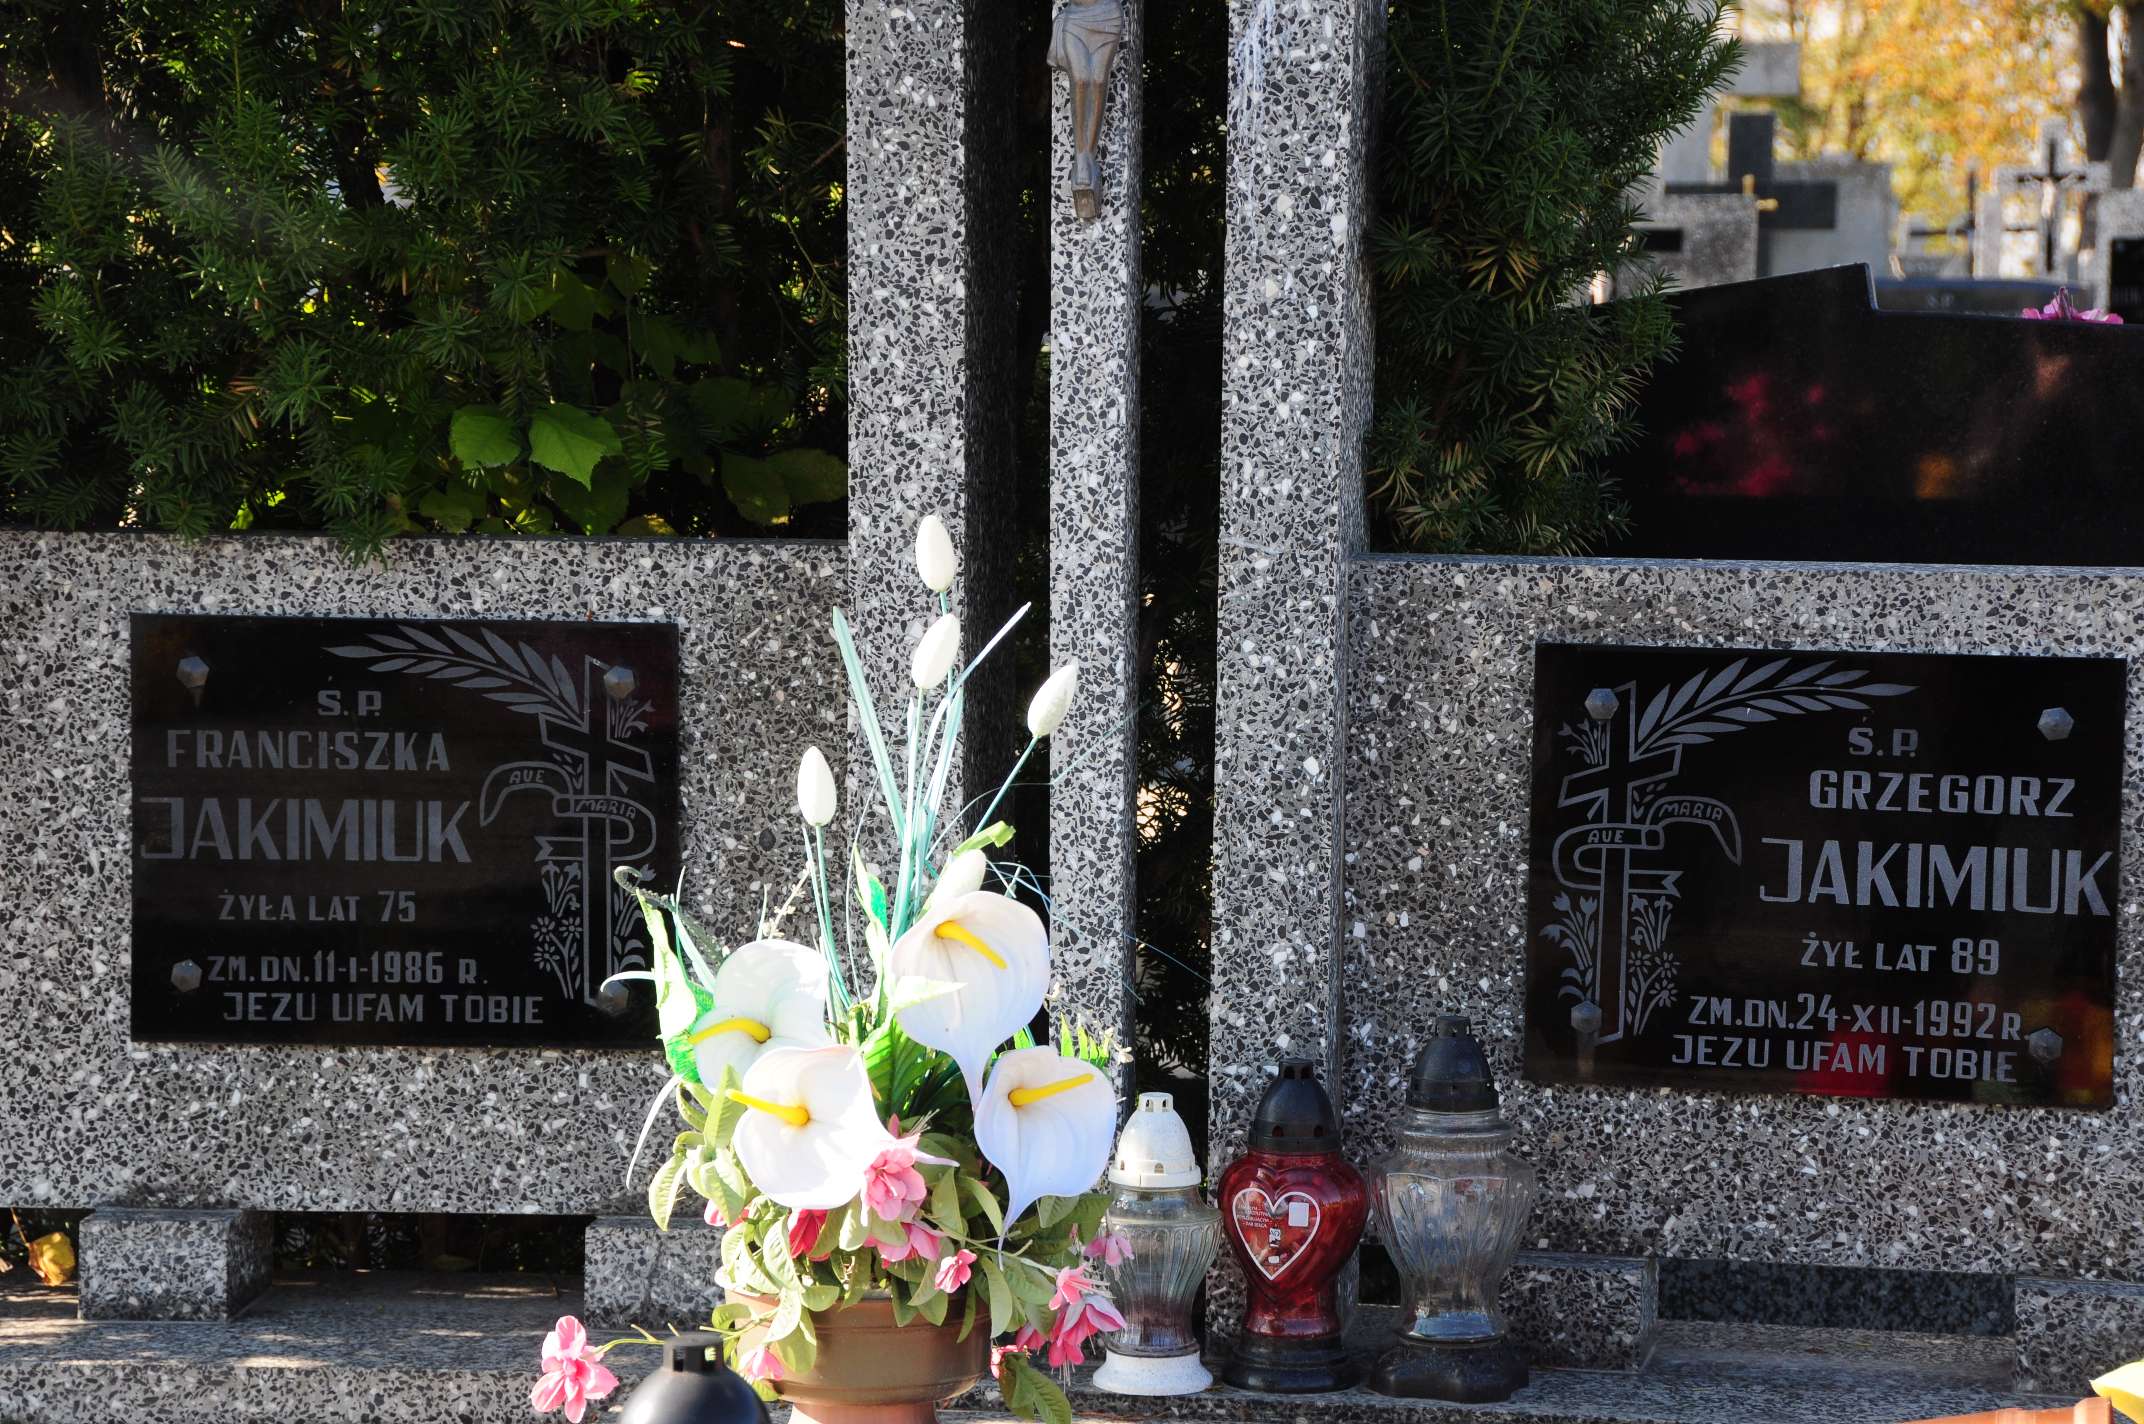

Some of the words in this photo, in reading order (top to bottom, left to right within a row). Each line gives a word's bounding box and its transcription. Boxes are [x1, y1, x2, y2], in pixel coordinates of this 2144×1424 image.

[166, 728, 450, 772] FRANCISZKA
[575, 799, 638, 820] MARIA
[1658, 801, 1724, 822] MARIA
[1808, 769, 2077, 818] GRZEGORZ
[139, 796, 473, 864] JAKIMIUK
[1758, 836, 2114, 917] JAKIMIUK
[217, 888, 297, 921] ŻYŁA
[308, 895, 361, 922] LAT
[377, 890, 417, 922] 75
[457, 958, 489, 985] R.
[1800, 931, 1864, 970] ŻYŁ
[1875, 943, 1937, 972] LAT
[1951, 937, 2000, 976] 89
[223, 992, 317, 1023] JEZU
[331, 993, 424, 1023] UFAM
[439, 994, 544, 1025] TOBIE
[1671, 1033, 1771, 1068] JEZU
[1785, 1039, 1886, 1076] UFAM
[1901, 1045, 2018, 1084] TOBIE
